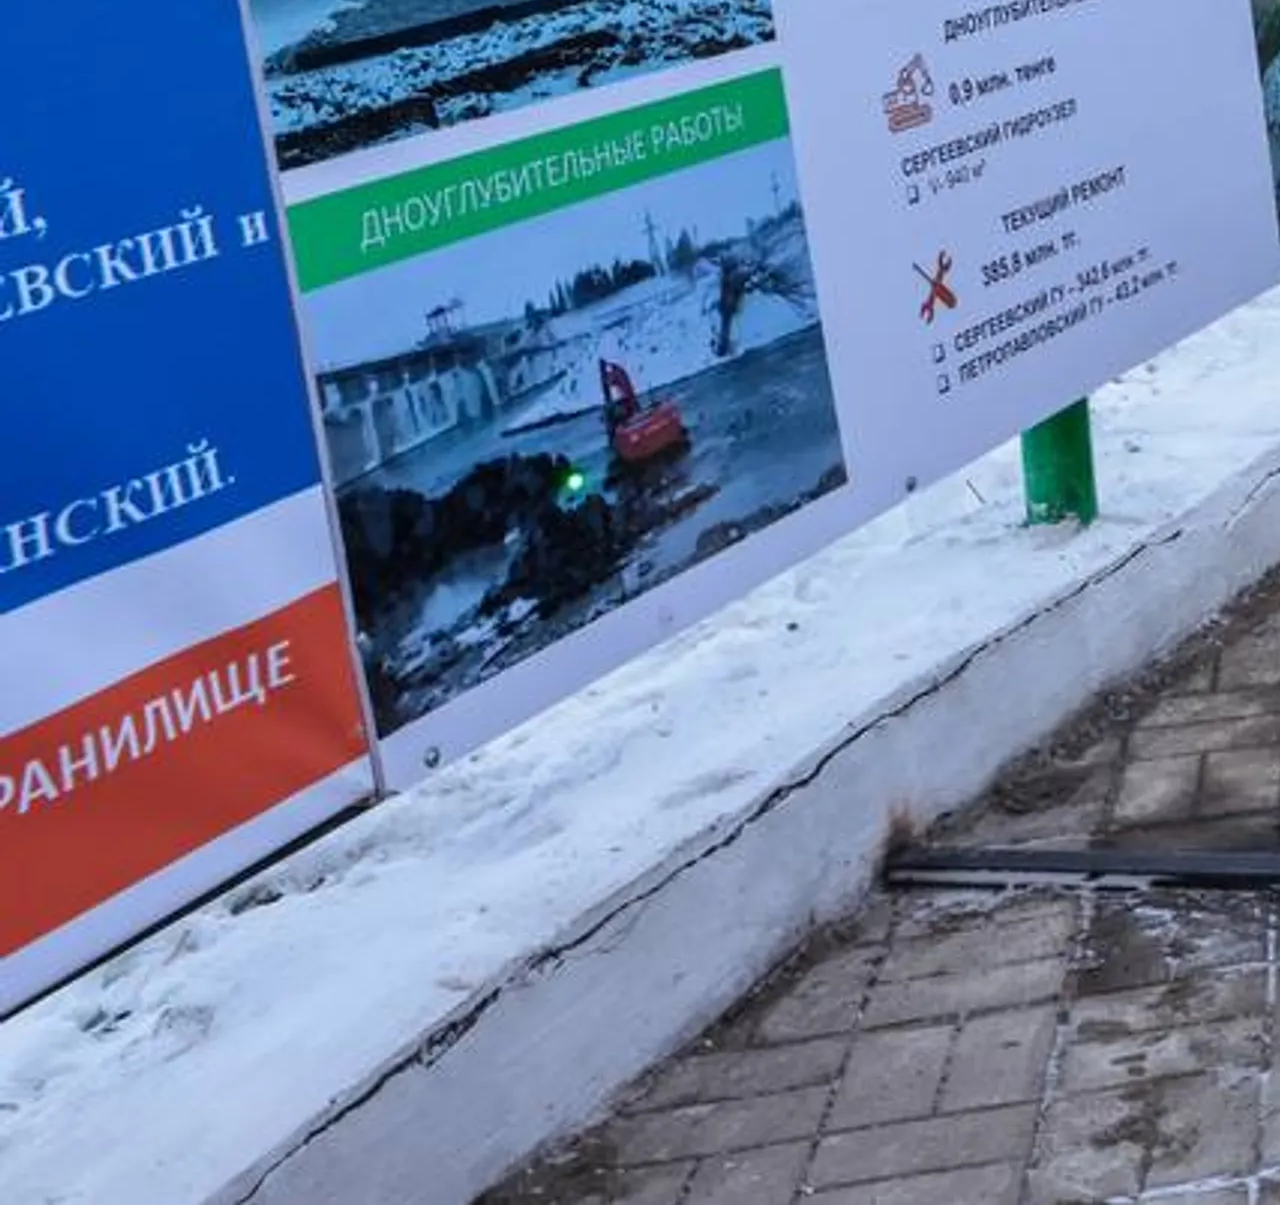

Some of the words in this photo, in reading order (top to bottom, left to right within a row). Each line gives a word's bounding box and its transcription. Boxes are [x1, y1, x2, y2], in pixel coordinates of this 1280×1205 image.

[949, 78, 974, 106] 0,9
[902, 120, 1001, 177] СЕРГЕЕВСКИЙ
[1002, 98, 1077, 142] ГИДРОУЗЕЛ
[359, 129, 646, 255] ДНОУГЛУБИТЕЛЬНЫЕ
[650, 103, 745, 154] РАБОТЫ
[1001, 185, 1070, 233] ТЕКУЩИЙ
[1072, 164, 1126, 206] РЕМОНТ
[0, 203, 219, 322] ВСКИЙ
[237, 211, 270, 247] и
[953, 288, 1049, 353] СЕРГЕЕВСКИЙ
[958, 300, 1088, 383] ПЕТРОПАВЛОВСКИЙ
[0, 439, 236, 574] НСКИЙ.
